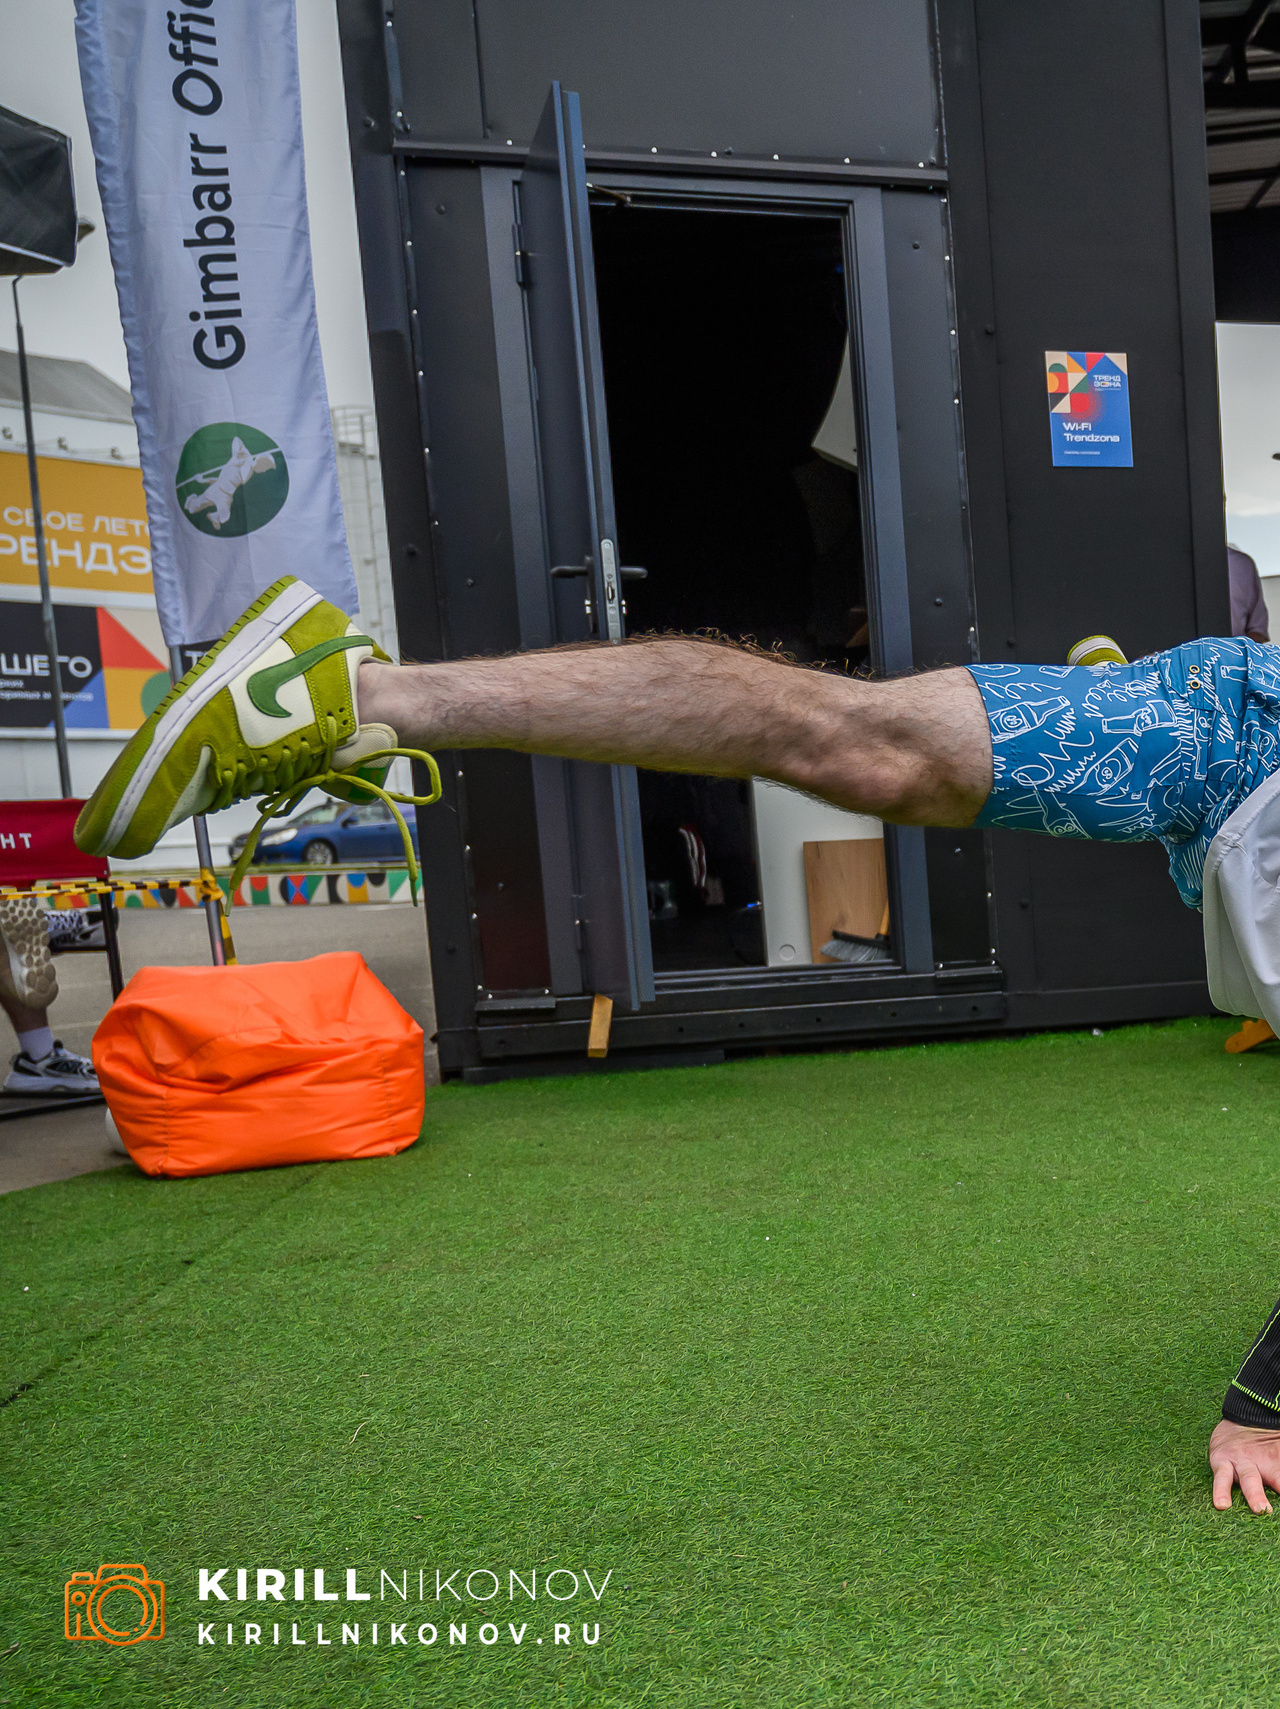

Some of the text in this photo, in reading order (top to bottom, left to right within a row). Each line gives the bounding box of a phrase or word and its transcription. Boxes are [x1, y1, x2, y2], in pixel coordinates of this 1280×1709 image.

[166, 0, 246, 370] Gimbarr Offi
[1093, 374, 1121, 382] ТРЕНД
[1063, 433, 1120, 442] Trendzona
[93, 515, 150, 537] ЛЕТ
